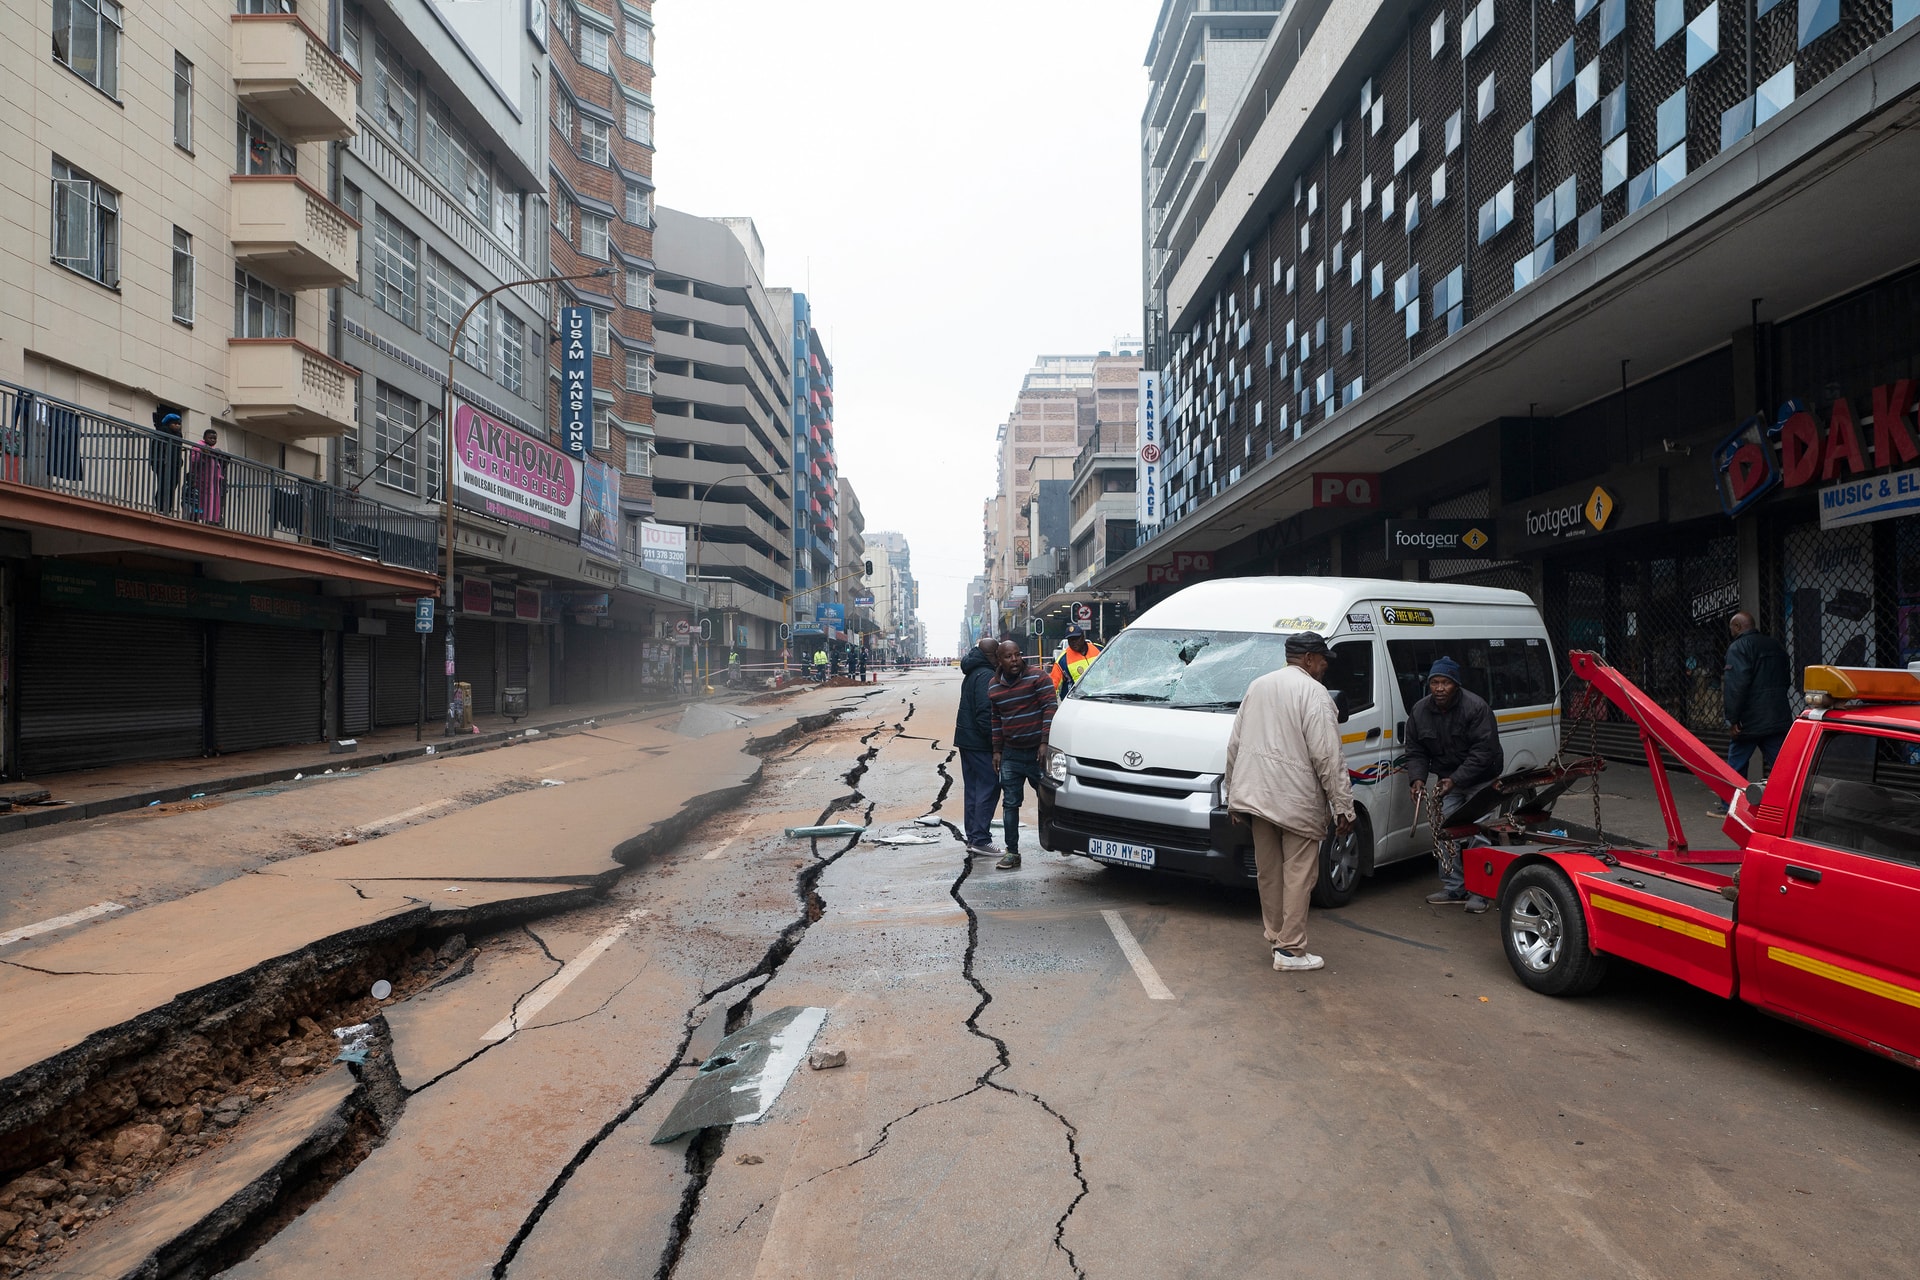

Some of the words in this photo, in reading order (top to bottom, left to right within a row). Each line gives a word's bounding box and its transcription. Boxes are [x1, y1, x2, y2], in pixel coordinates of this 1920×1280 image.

[569, 310, 584, 359] LUSAM
[569, 370, 584, 451] MANSIONS
[1780, 378, 1920, 489] DAK
[466, 413, 567, 488] AKHONA
[467, 450, 566, 503] FURNISHERS
[463, 471, 497, 494] WHOLESALE
[497, 483, 525, 505] FURNITURE
[525, 497, 529, 506] &
[529, 498, 553, 515] APPLIANCE
[553, 507, 567, 520] STORE
[1147, 466, 1155, 516] PLACE
[1321, 478, 1372, 504] PQ
[1823, 483, 1872, 509] MUSIC
[1878, 479, 1891, 497] &
[1526, 503, 1583, 537] footgear
[644, 527, 660, 543] TO
[663, 531, 682, 545] LET
[1395, 530, 1459, 549] footgear
[656, 550, 668, 559] 378
[669, 552, 684, 560] 3200
[1178, 555, 1210, 571] PQ
[114, 578, 146, 599] FAIR
[149, 583, 187, 601] PRICE
[250, 594, 272, 612] FAIR
[420, 606, 429, 616] R
[1395, 610, 1408, 622] FREE
[1408, 611, 1420, 622] WI-FI
[1091, 840, 1102, 854] JH
[1106, 843, 1118, 856] 89
[1121, 845, 1133, 859] MY
[1141, 848, 1153, 862] GP
